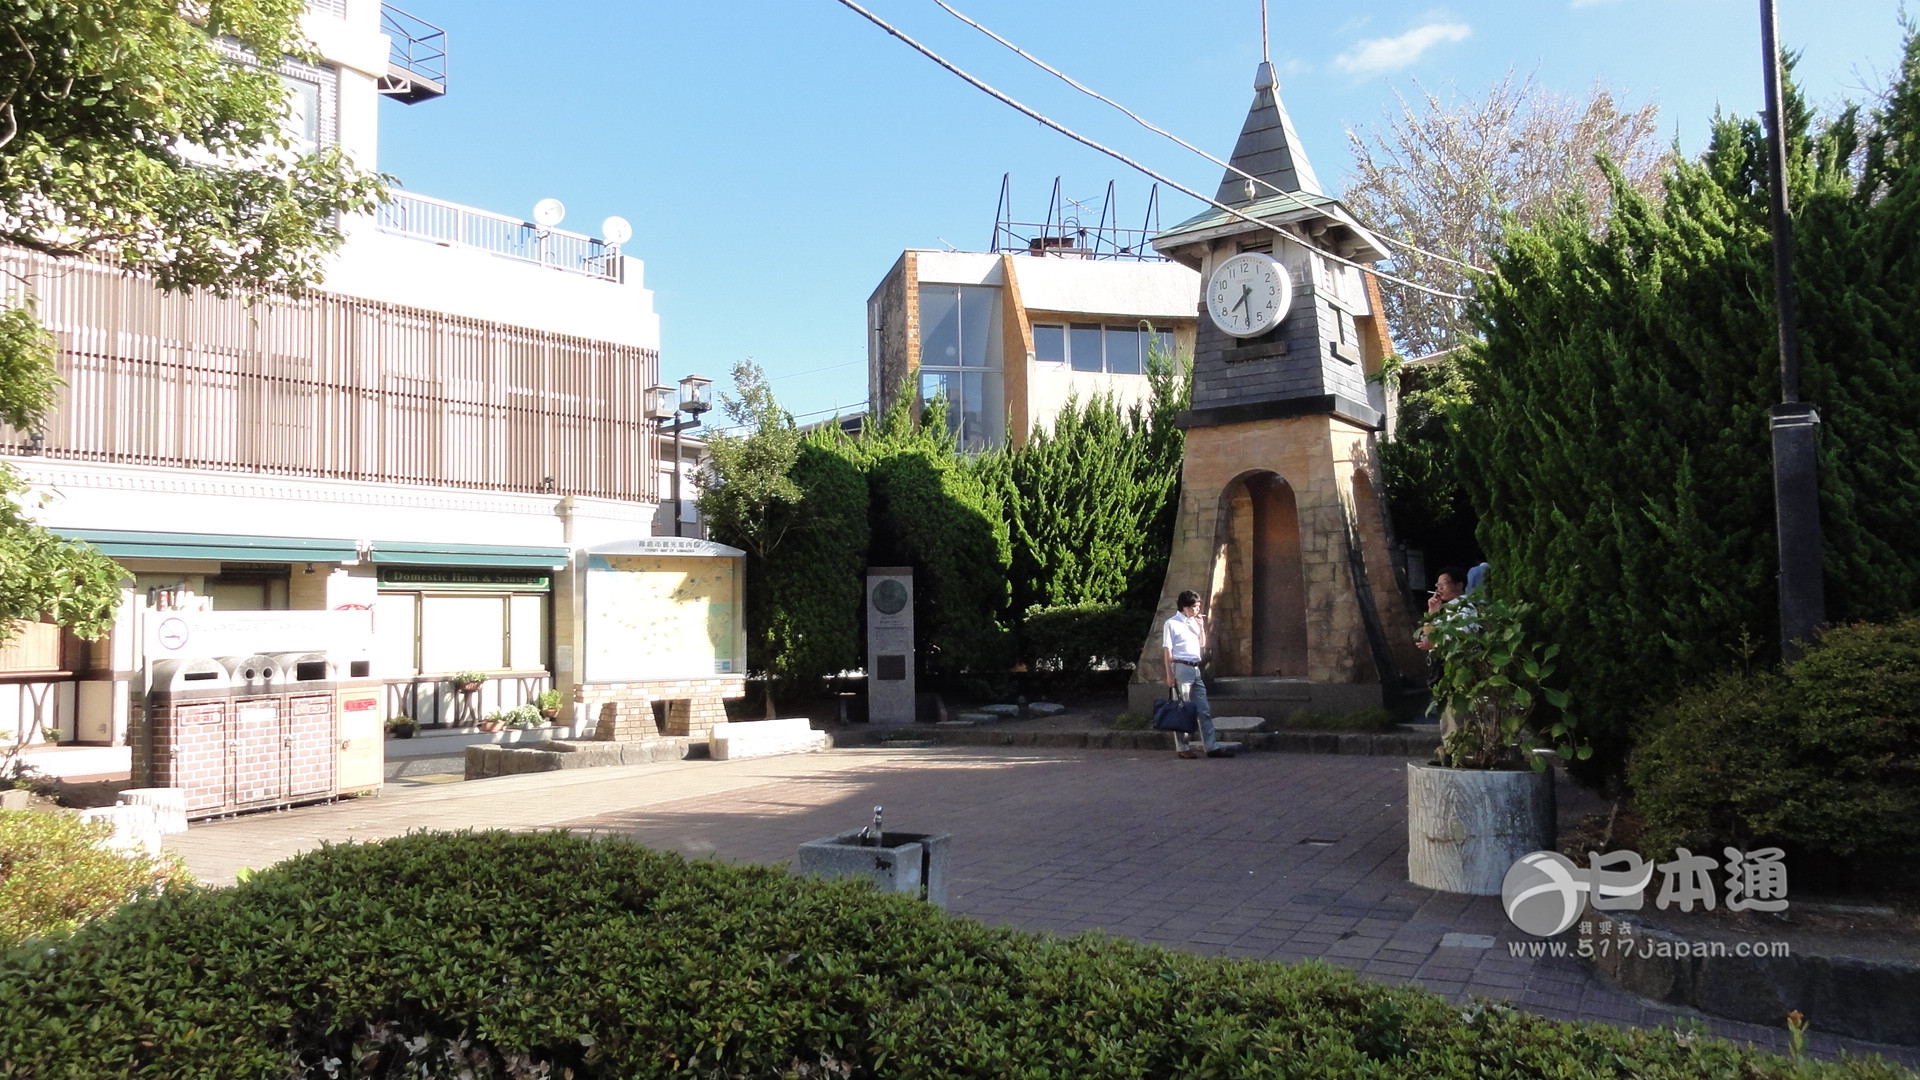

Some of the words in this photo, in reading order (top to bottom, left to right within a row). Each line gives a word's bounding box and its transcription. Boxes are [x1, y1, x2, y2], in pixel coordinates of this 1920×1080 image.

[1240, 263, 1249, 273] 12
[1229, 269, 1236, 279] 11
[1265, 273, 1271, 282] 2
[1219, 281, 1228, 290] 10
[1269, 286, 1275, 296] 3
[1217, 294, 1224, 303] 9
[1266, 300, 1272, 310] 4
[1222, 306, 1228, 316] 8
[1232, 315, 1239, 325] 7
[1256, 312, 1263, 321] 5
[394, 571, 447, 582] Domestic
[452, 573, 478, 582] Ham
[482, 574, 491, 582] &
[496, 574, 539, 585] Sausage
